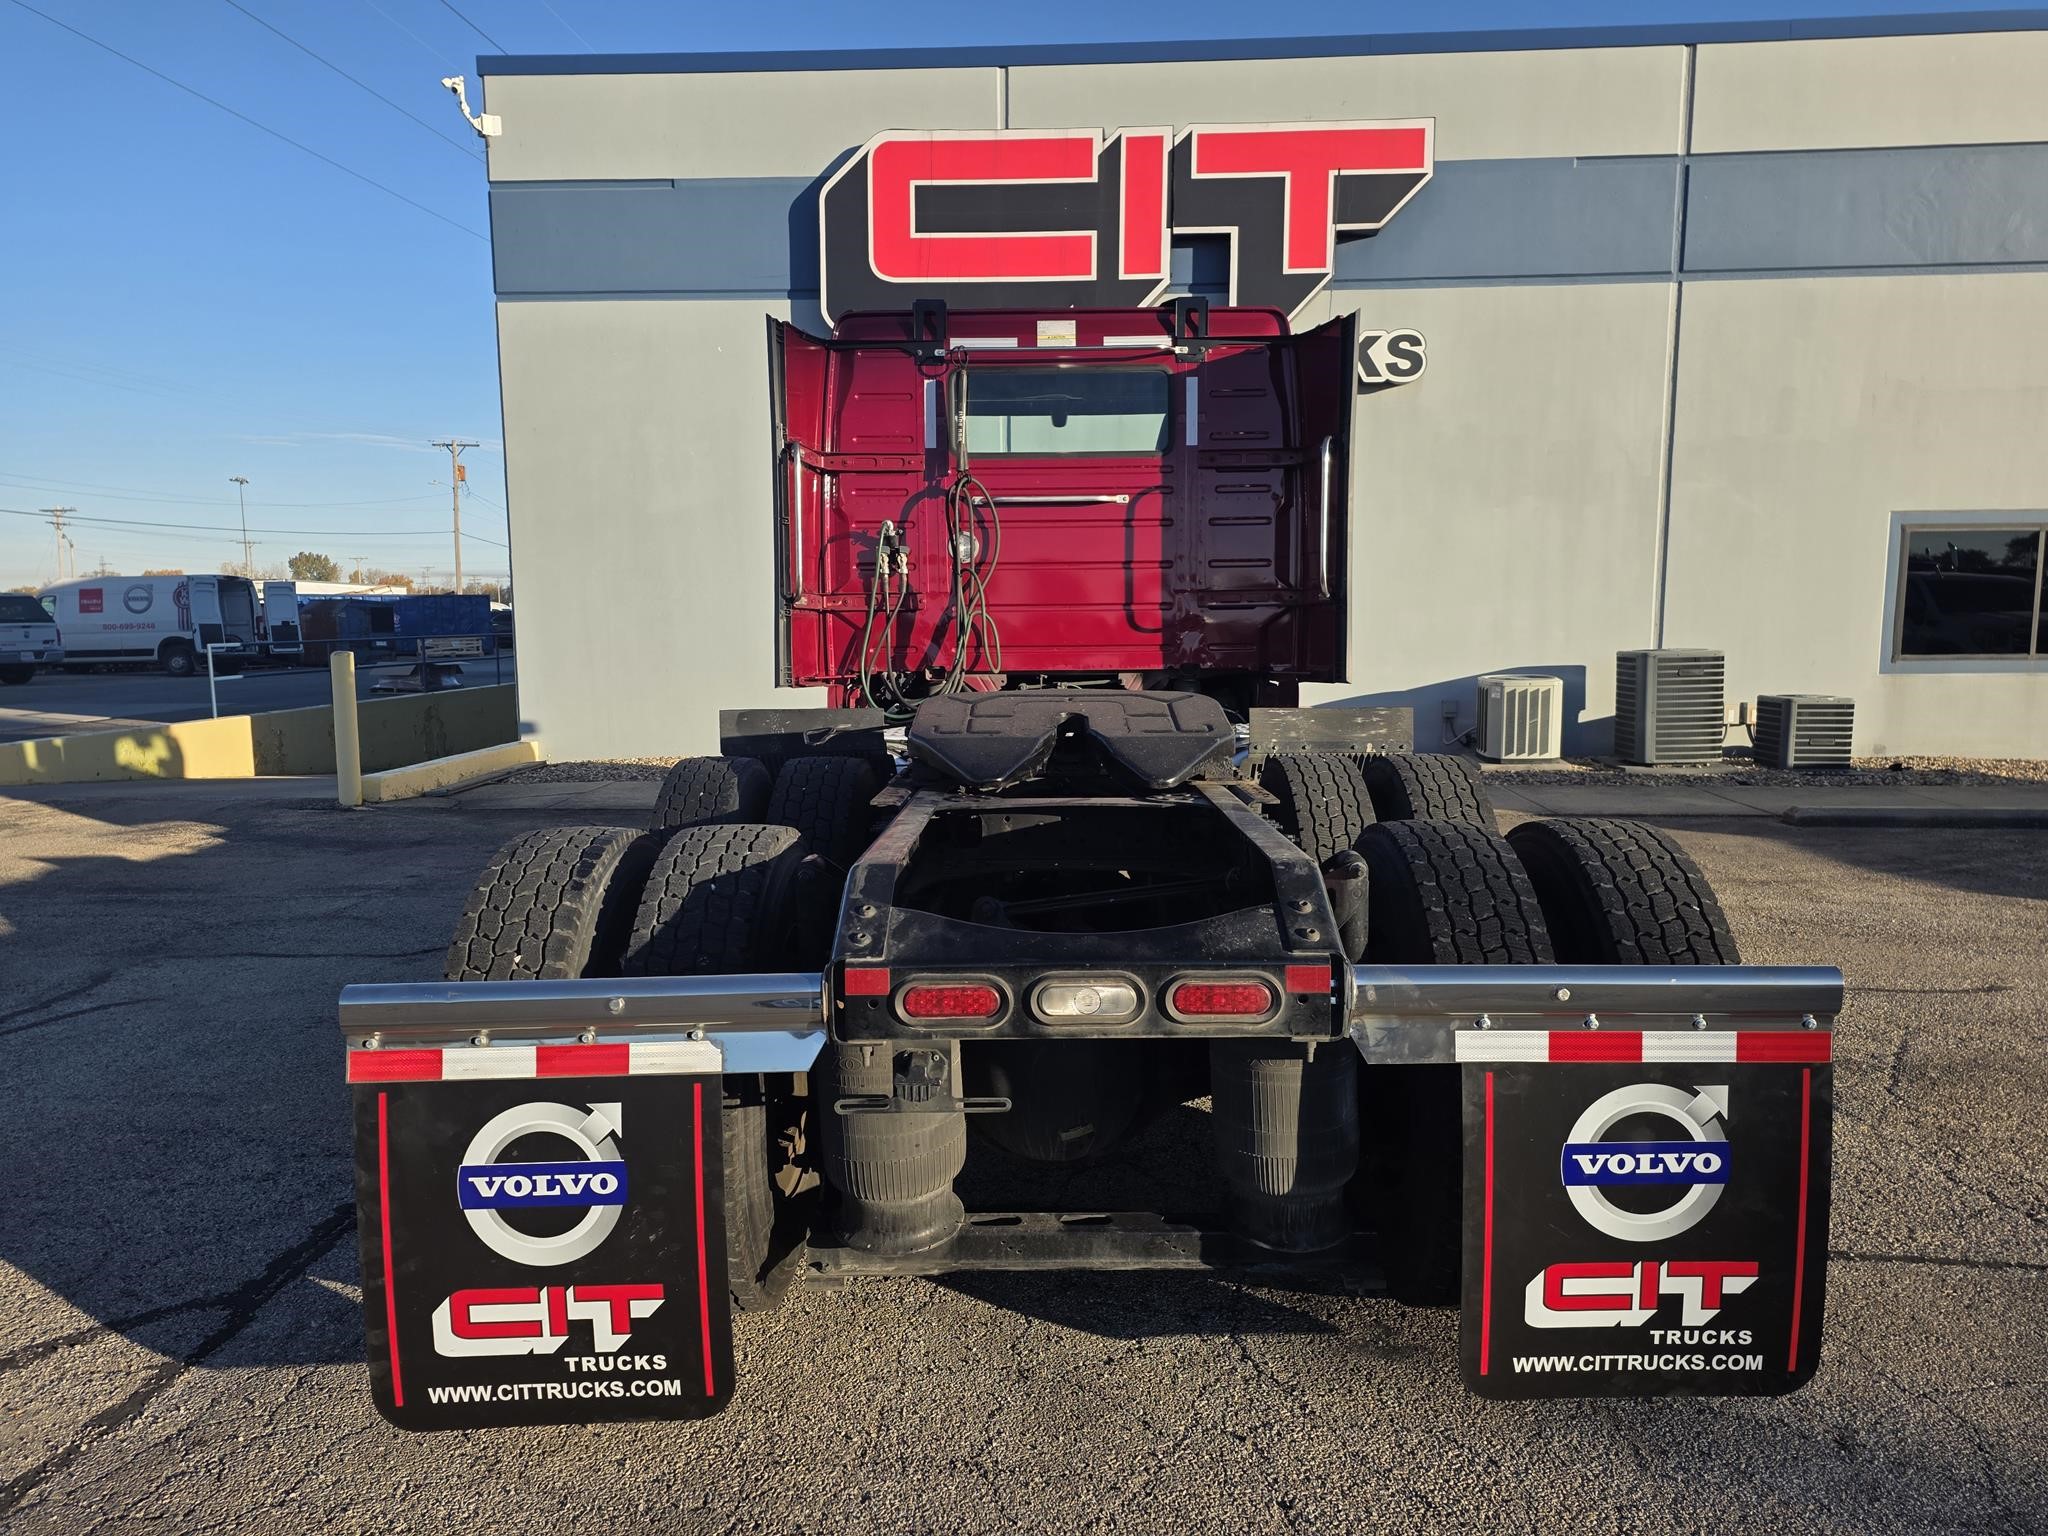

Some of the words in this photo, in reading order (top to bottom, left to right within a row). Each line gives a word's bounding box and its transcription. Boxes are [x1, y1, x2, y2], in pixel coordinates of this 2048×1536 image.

[866, 118, 1434, 284] CIT
[1572, 1152, 1722, 1175] VOLVO
[467, 1172, 619, 1198] VOLVO
[1542, 1260, 1760, 1312] CIT
[448, 1283, 666, 1341] CIT
[1649, 1329, 1753, 1345] TRUCKS
[563, 1354, 668, 1373] TRUCKS
[1512, 1354, 1764, 1373] WWW.CITTRUCKS.COM
[427, 1379, 682, 1404] WWW.CITTRUCKS.COM
